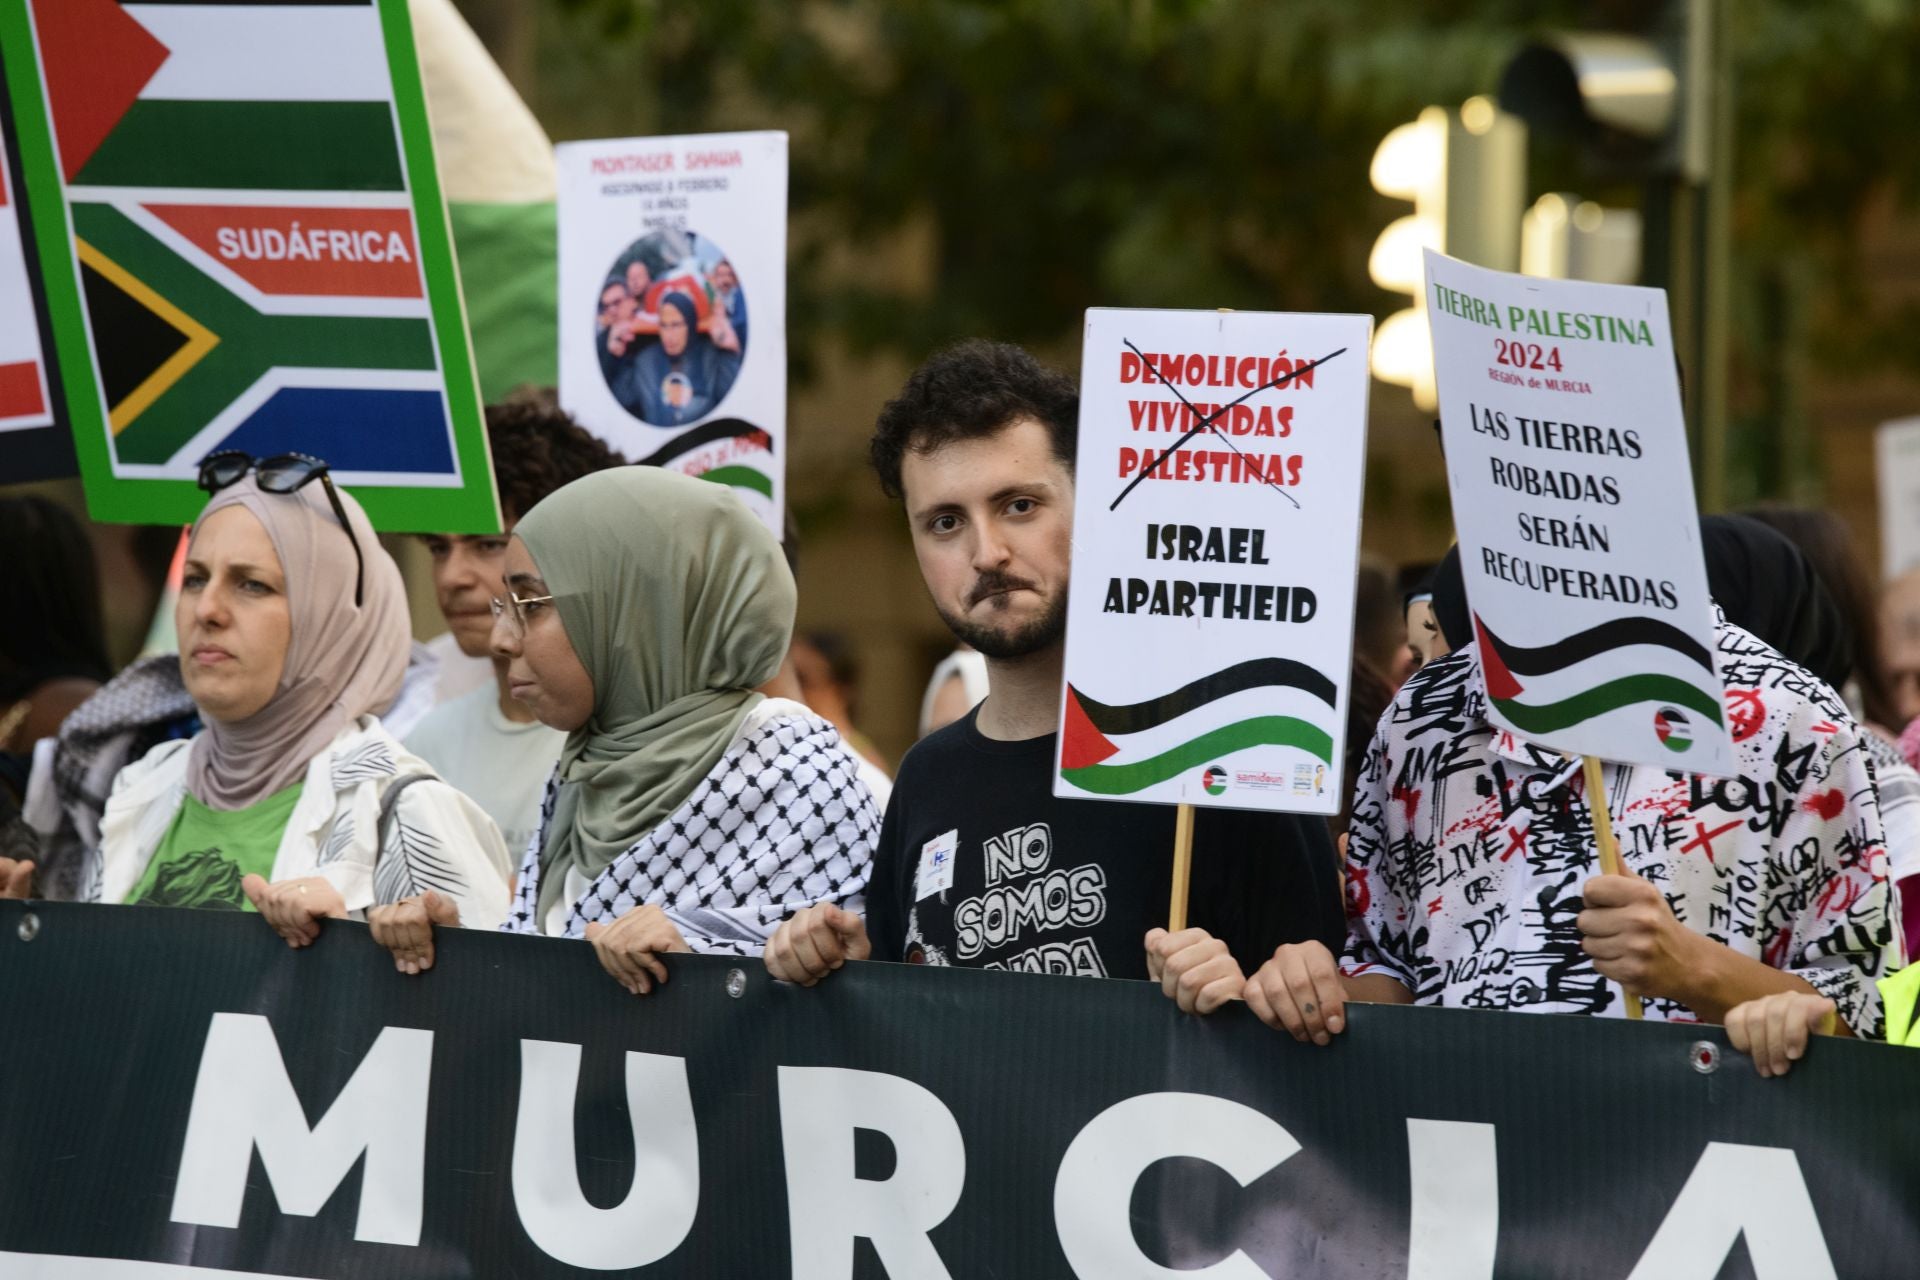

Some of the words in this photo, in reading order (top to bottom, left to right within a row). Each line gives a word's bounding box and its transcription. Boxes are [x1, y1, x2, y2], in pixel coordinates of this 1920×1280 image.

[217, 221, 412, 262] SUDÁFRICA
[1433, 283, 1502, 330] TIERRA
[1508, 306, 1655, 347] PALESTINA
[1120, 349, 1316, 390] DEMOLICIÓN
[1494, 338, 1564, 373] 2024
[1528, 377, 1542, 389] de
[1545, 378, 1593, 394] MURCIA
[1128, 400, 1294, 438] VIVIENDAS
[1469, 402, 1510, 441] LAS
[1515, 416, 1643, 460] TIERRAS
[1118, 447, 1303, 486] PALESTINAS
[1490, 456, 1621, 506] ROBADAS
[1146, 523, 1270, 565] ISRAEL
[1518, 514, 1610, 553] SERÁN
[1481, 546, 1679, 610] RECUPERADAS
[1103, 577, 1317, 624] APARTHEID
[983, 822, 1052, 888] NO
[954, 863, 1107, 960] SOMOS
[983, 936, 1109, 978] ADA
[170, 1012, 1836, 1280] MURCIA
